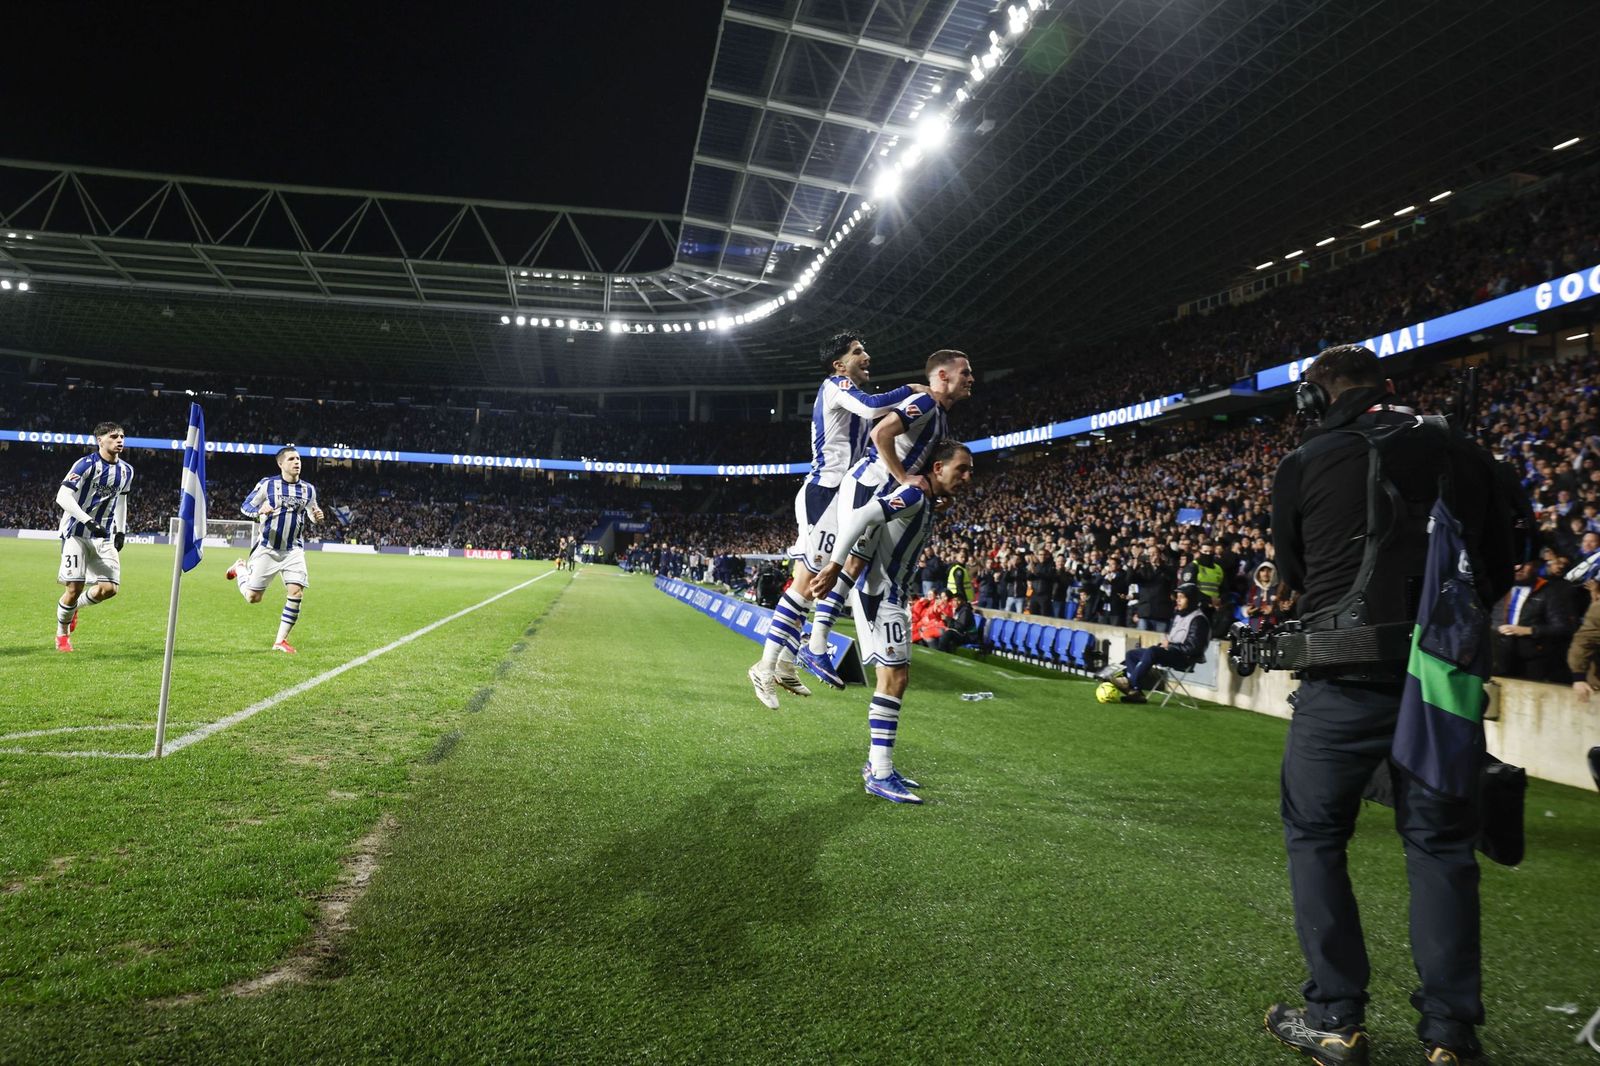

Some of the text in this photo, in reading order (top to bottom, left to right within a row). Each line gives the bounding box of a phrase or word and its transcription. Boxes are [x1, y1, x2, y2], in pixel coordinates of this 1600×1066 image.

[990, 424, 1053, 450] GOOOLAAA!
[309, 446, 400, 461] GOOOLAAA!
[452, 454, 541, 469] GOOOLAAA!
[584, 461, 671, 474] GOOOLAAA!
[717, 463, 790, 475] GOOOLAAA!
[818, 530, 836, 554] 18
[64, 554, 79, 569] 31
[466, 550, 498, 559] LALIGA
[883, 621, 903, 644] 10
